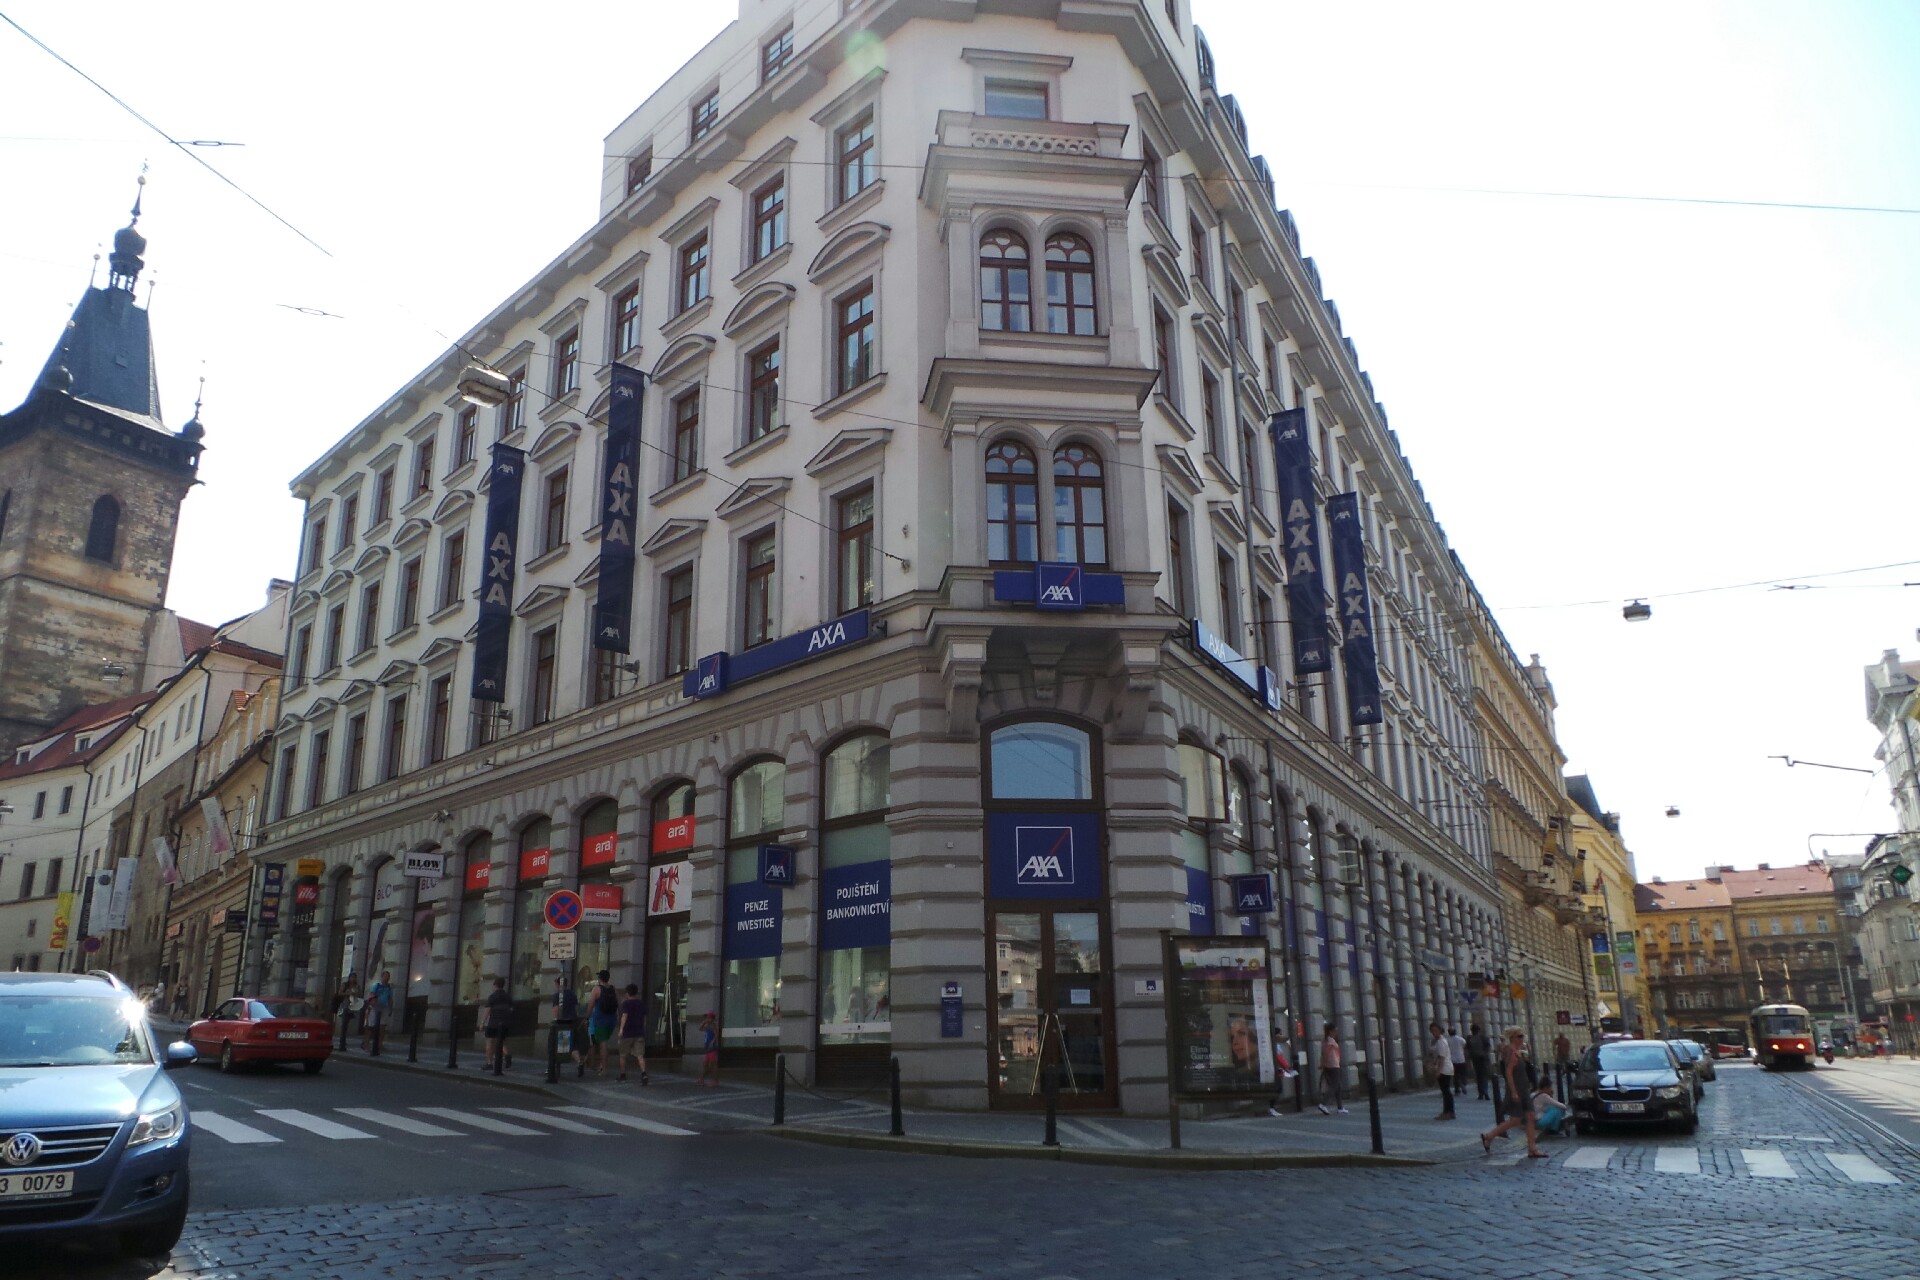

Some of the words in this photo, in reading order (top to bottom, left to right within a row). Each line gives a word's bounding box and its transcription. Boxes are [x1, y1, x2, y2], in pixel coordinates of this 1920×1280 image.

[1278, 429, 1298, 441] AXA
[605, 461, 633, 547] AXA
[1287, 498, 1316, 577] AXA
[485, 531, 513, 607] AXA
[1041, 584, 1074, 602] AXA
[1342, 571, 1369, 640] AXA
[600, 625, 620, 640] AXA
[807, 621, 846, 652] AXA
[1208, 632, 1227, 661] AXA
[1300, 649, 1321, 663] AXA
[698, 674, 716, 691] AXA
[668, 824, 686, 839] ara
[595, 839, 611, 853] ara
[408, 858, 441, 869] BLOW
[532, 854, 546, 867] ara
[1018, 855, 1064, 878] AXA
[475, 867, 488, 878] ara
[765, 864, 786, 879] AXA
[836, 880, 880, 900] POJIŠTĚNÍ
[744, 899, 769, 913] PENZE
[1239, 893, 1263, 907] AXA
[826, 898, 890, 920] BANKOVNICTVÍ
[737, 917, 775, 932] INVESTICE
[23, 1175, 65, 1191] 0079
